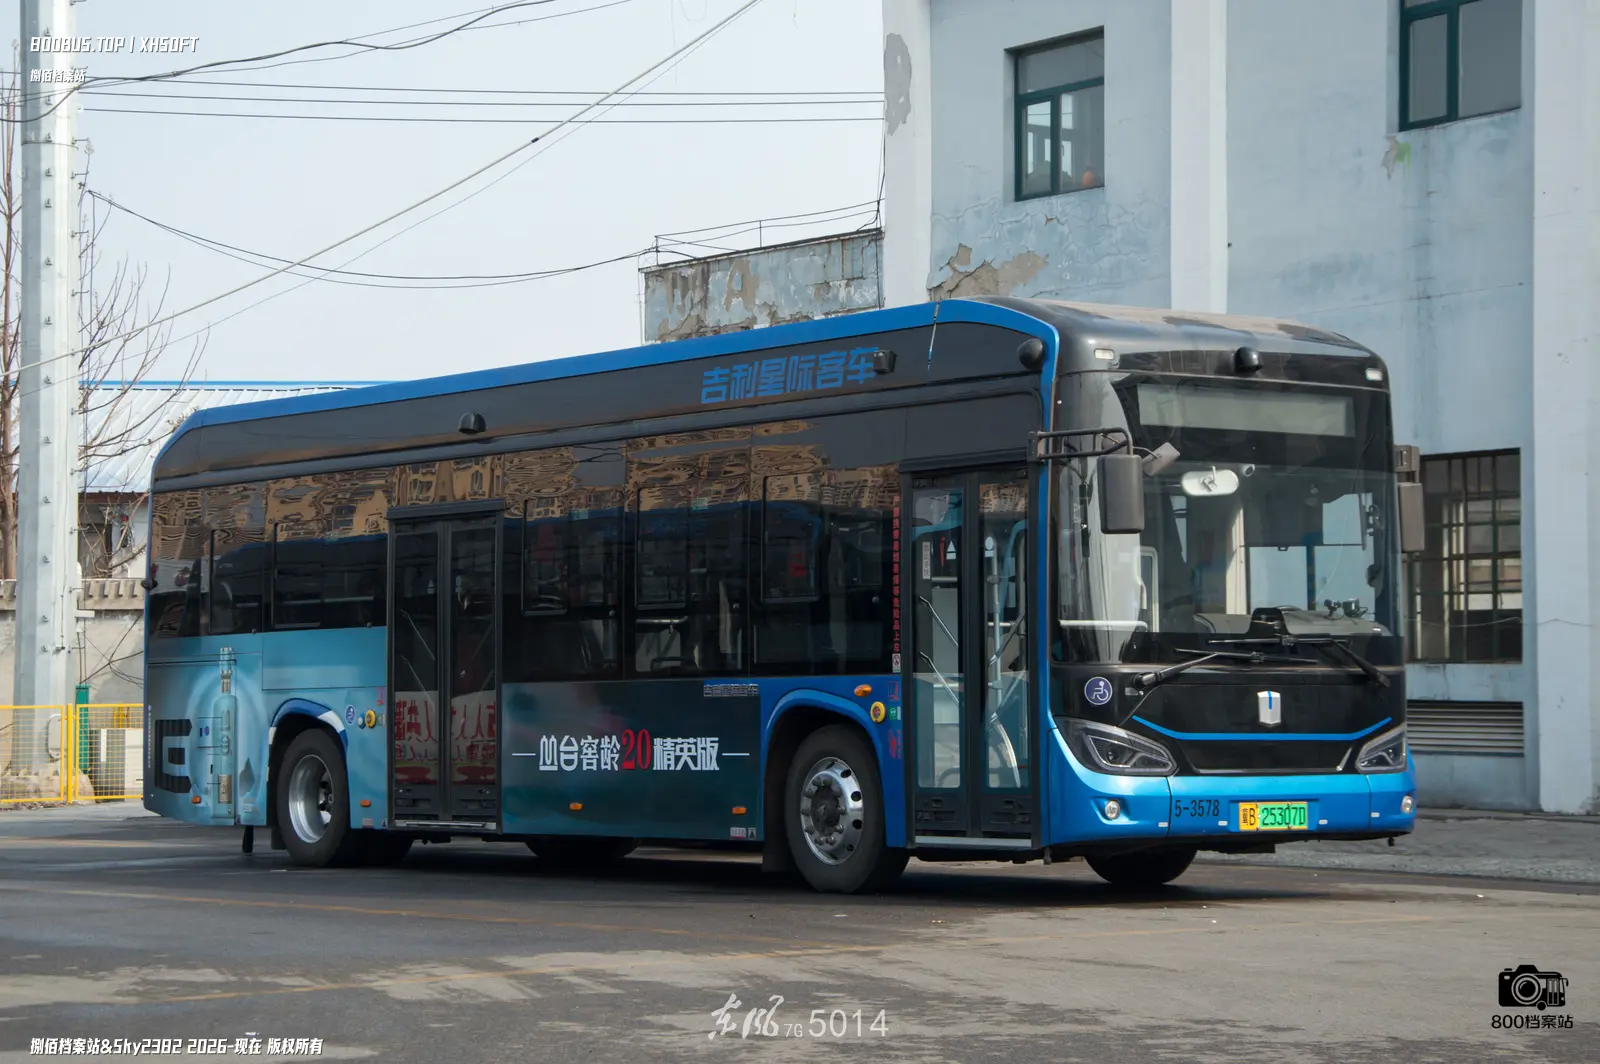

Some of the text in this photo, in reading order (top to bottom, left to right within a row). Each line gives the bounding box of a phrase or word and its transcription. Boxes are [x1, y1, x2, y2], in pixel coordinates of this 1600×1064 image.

[701, 347, 879, 405] 吉利星际客车
[1174, 799, 1220, 818] 5-3578
